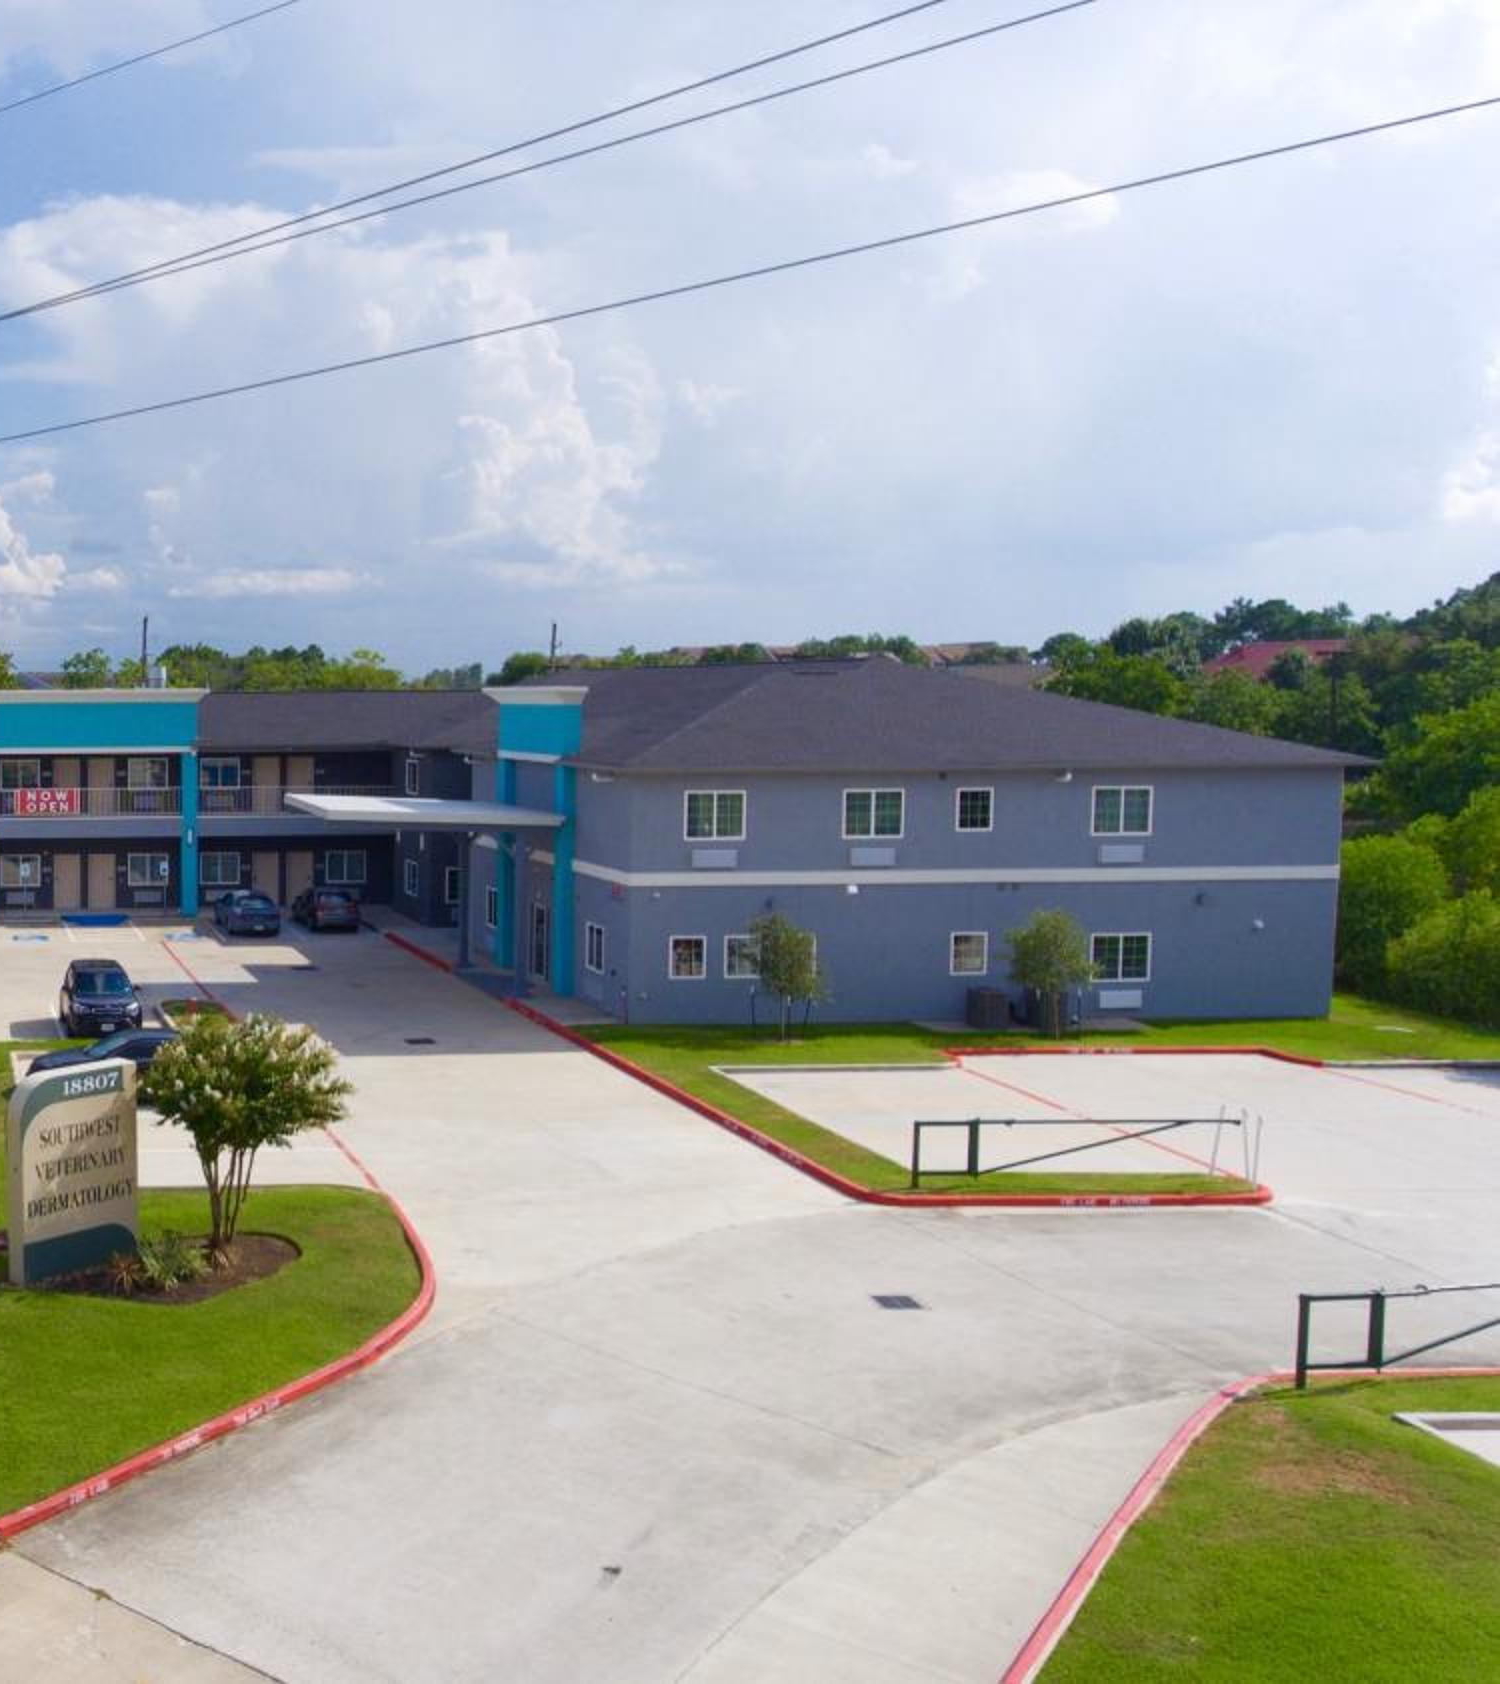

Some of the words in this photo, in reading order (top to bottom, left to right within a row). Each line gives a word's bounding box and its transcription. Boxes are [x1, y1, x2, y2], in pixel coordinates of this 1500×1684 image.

[26, 801, 69, 812] OPEN
[27, 790, 68, 801] NOW
[63, 1071, 119, 1096] 18807
[39, 1115, 120, 1148] SOUTHWEST
[35, 1146, 125, 1181] VETERINARY
[27, 1179, 133, 1218] DERMATOLOGY
